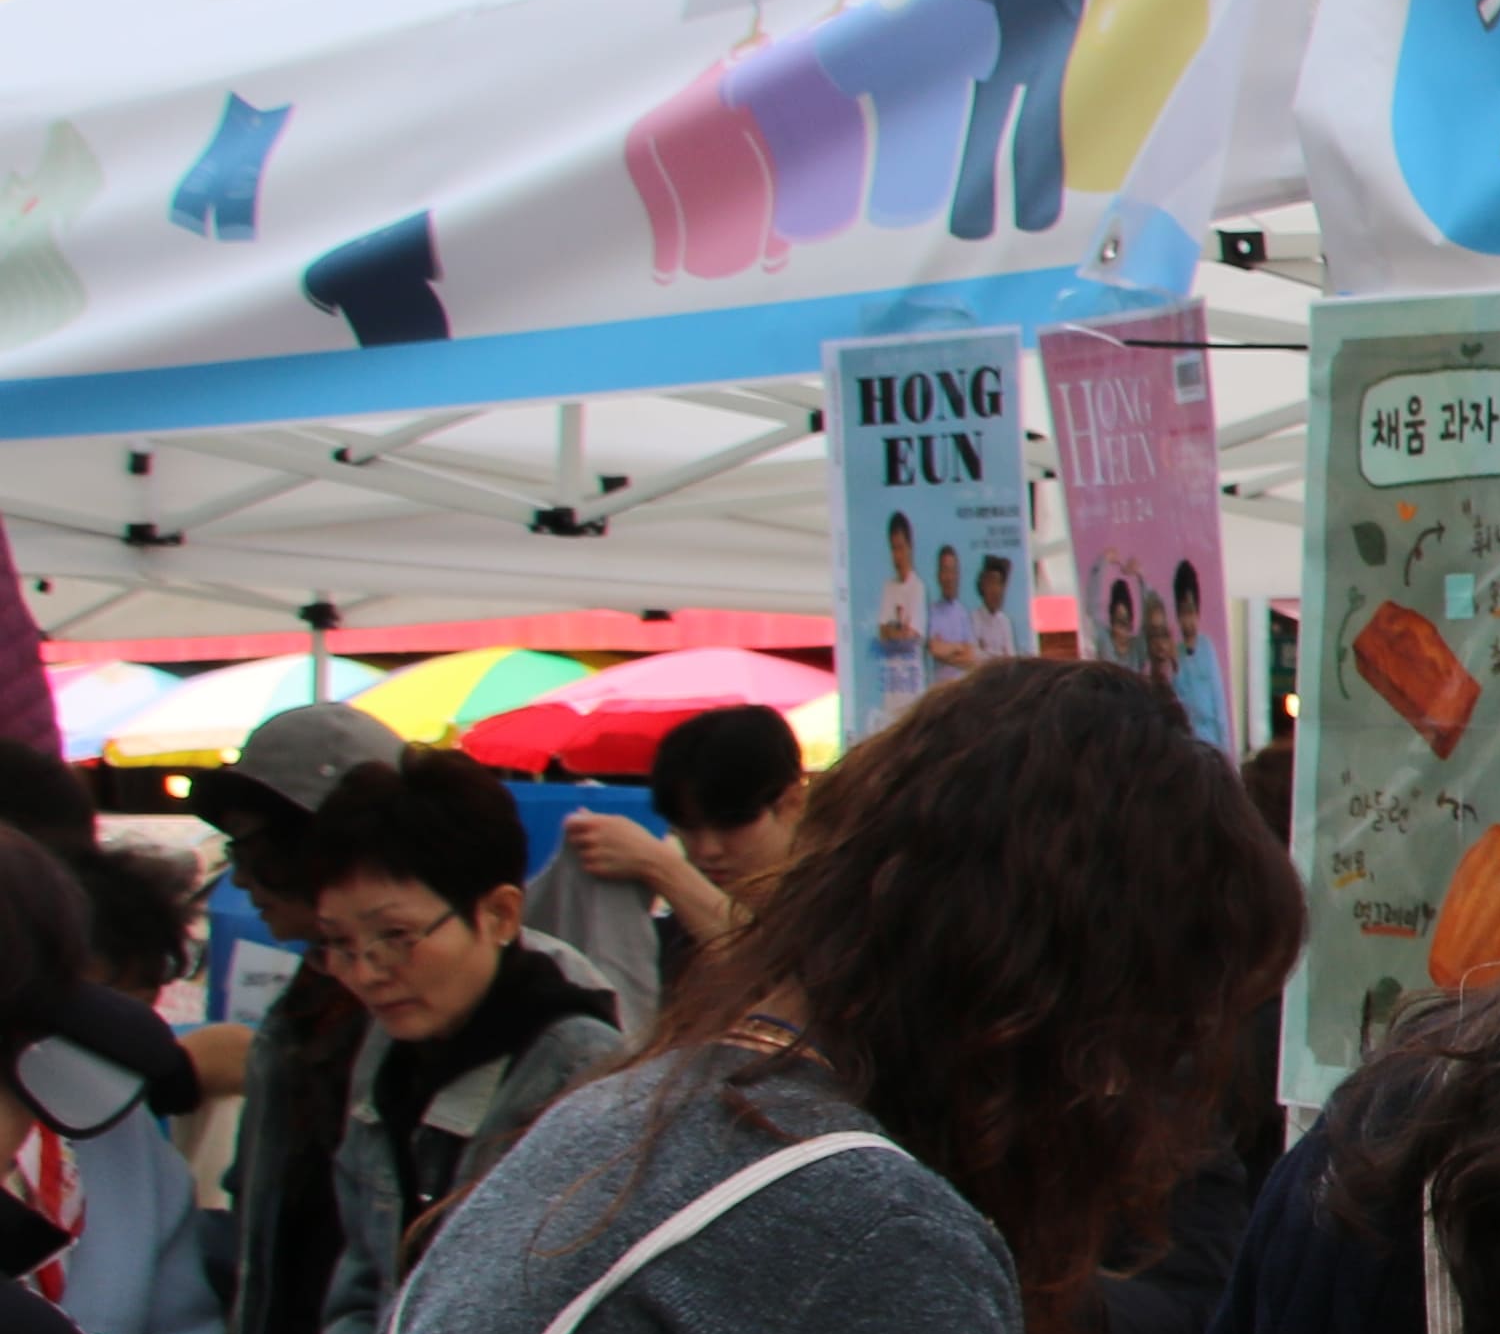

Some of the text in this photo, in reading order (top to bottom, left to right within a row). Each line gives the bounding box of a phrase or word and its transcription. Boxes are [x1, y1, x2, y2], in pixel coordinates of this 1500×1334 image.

[857, 364, 1004, 427] HONG
[1371, 395, 1427, 456] 채움
[1440, 397, 1500, 444] 과자
[883, 430, 984, 487] EUN
